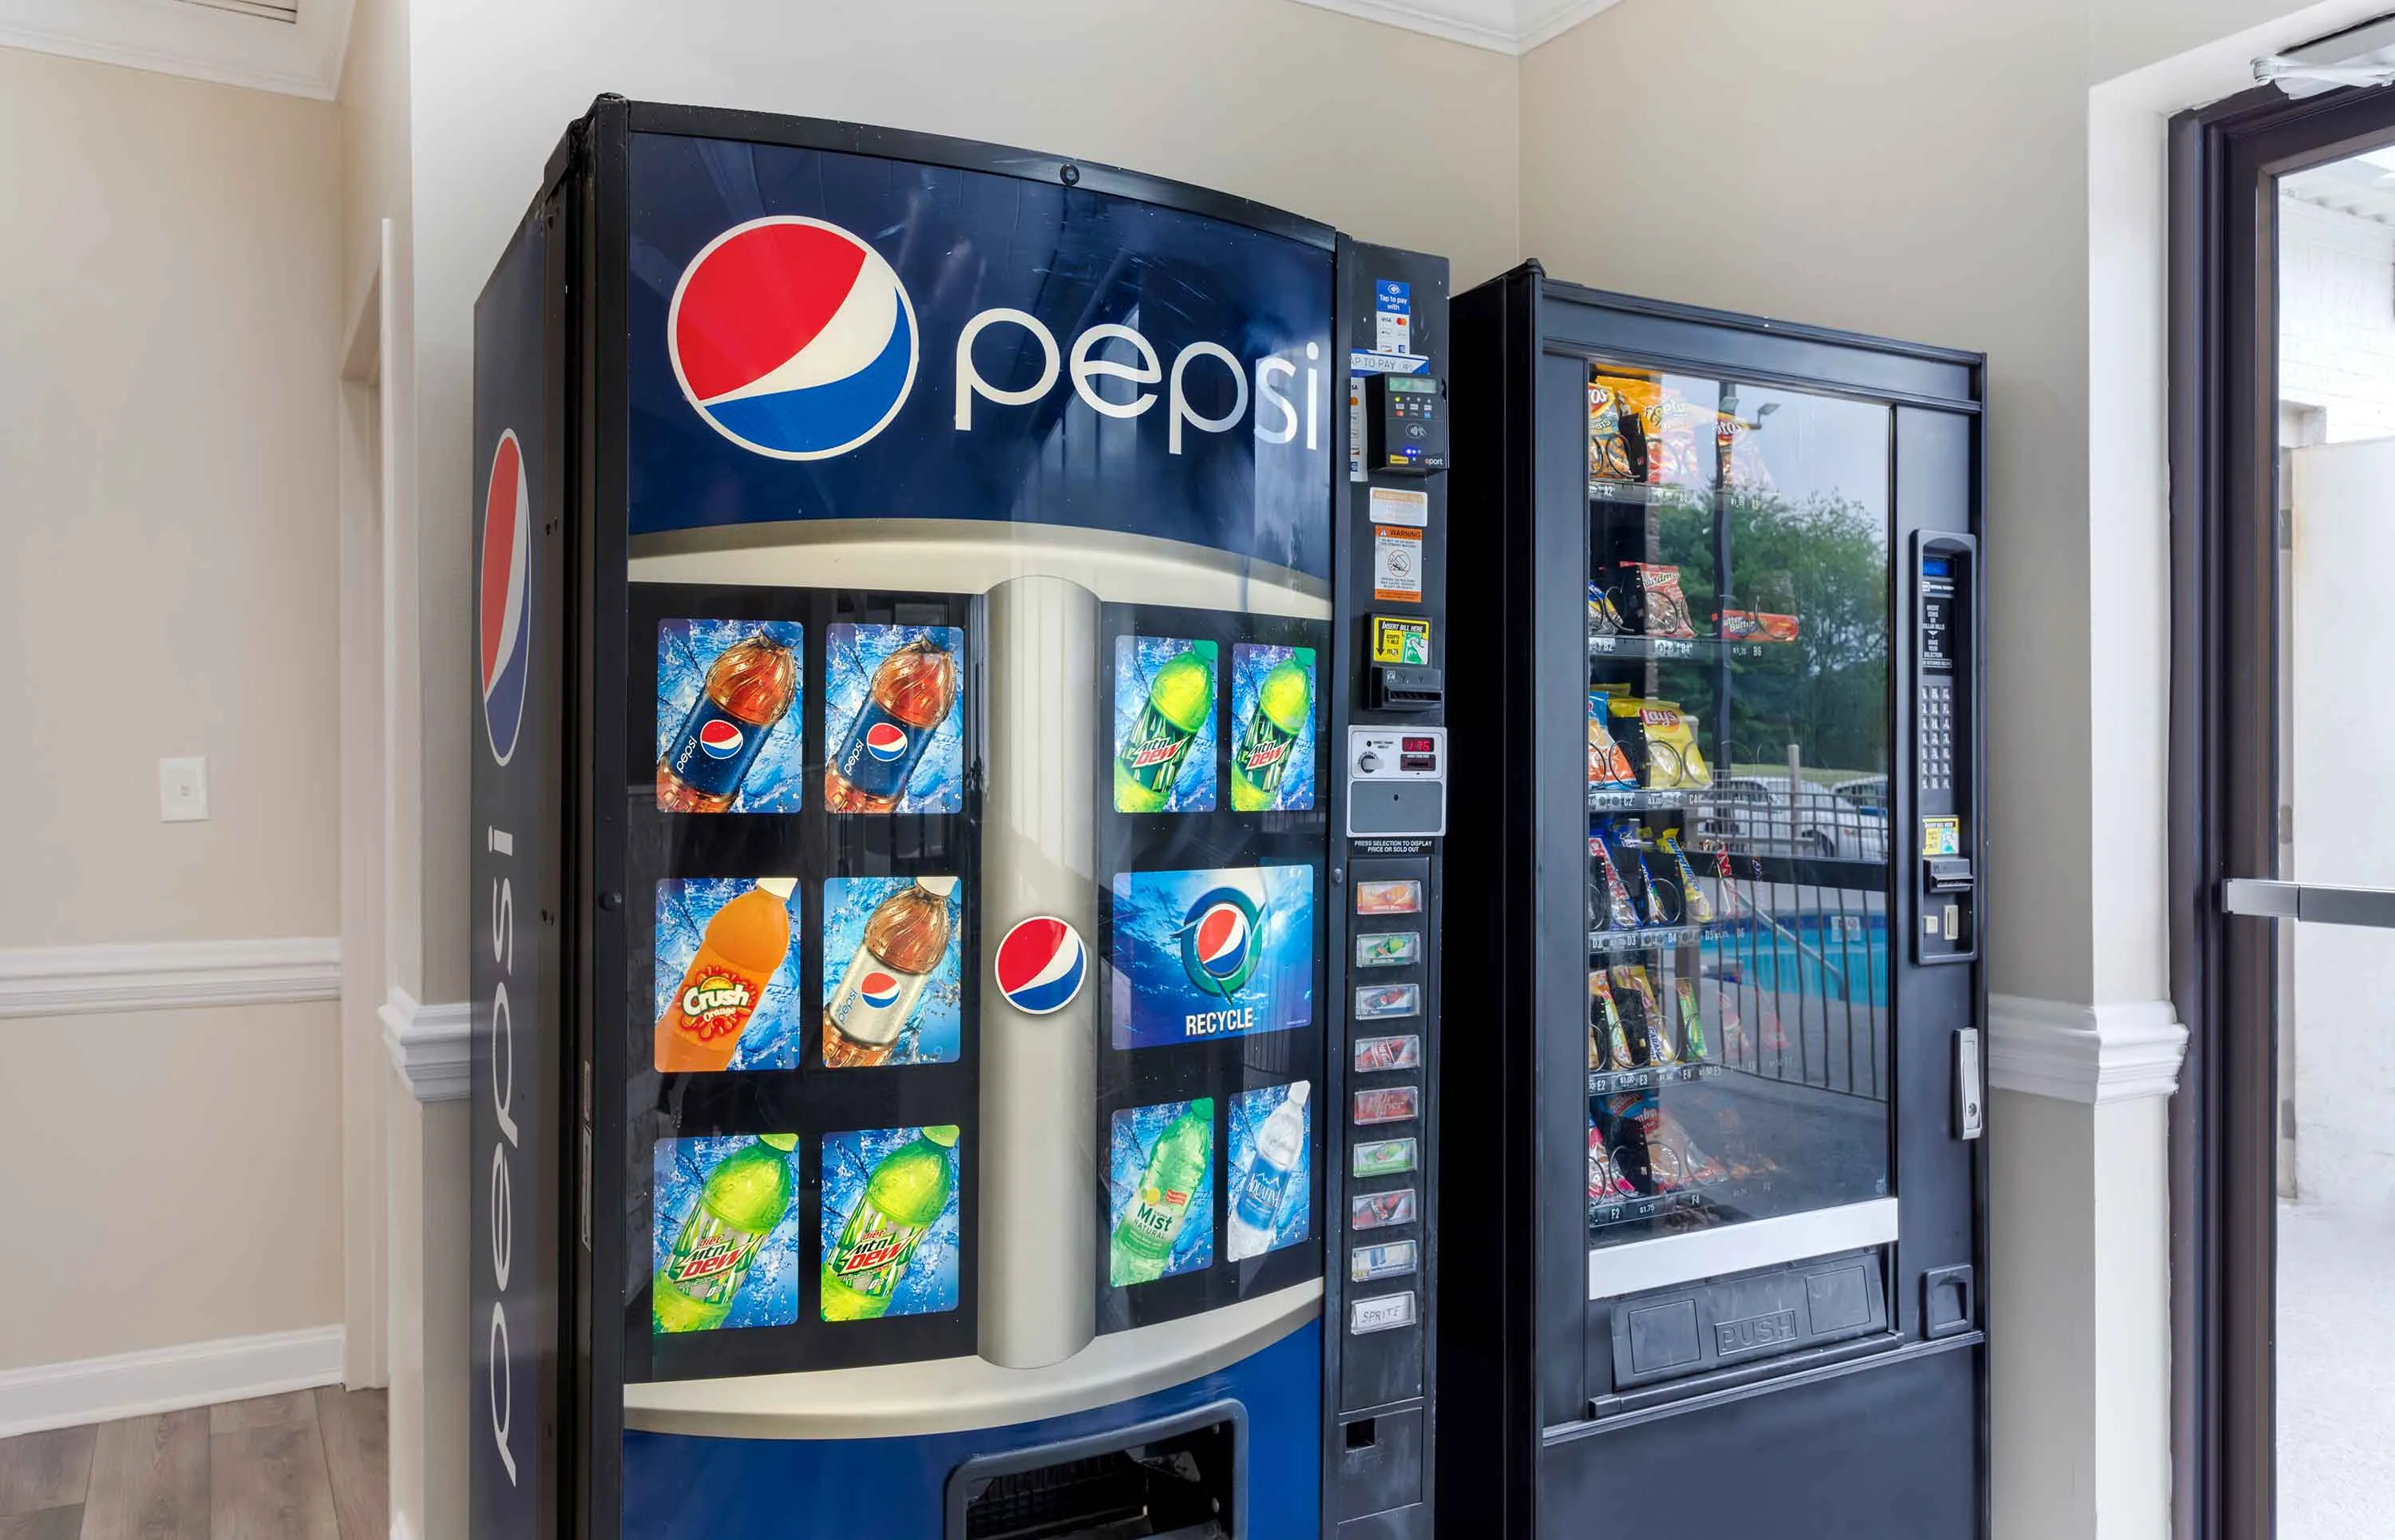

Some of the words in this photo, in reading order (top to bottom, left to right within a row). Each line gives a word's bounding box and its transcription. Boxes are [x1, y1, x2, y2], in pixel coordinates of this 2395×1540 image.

[1380, 294, 1390, 303] Tap
[1351, 356, 1361, 366] AP
[1363, 358, 1376, 367] TO
[1378, 360, 1396, 369] PAY
[955, 307, 1320, 454] pepsi
[1390, 529, 1421, 538] WARNING
[677, 737, 696, 773] pepsi
[844, 741, 864, 776] pepsi
[683, 984, 750, 1015] Crush
[838, 988, 857, 1025] pepsi
[703, 1007, 736, 1022] Orange
[1186, 1008, 1253, 1036] RECYCLE
[489, 825, 517, 1487] pepsi
[1134, 1219, 1166, 1239] NATURAL
[1137, 1202, 1172, 1232] Mist
[699, 1236, 722, 1247] diet
[862, 1229, 885, 1240] diet
[1722, 1314, 1795, 1351] PUSH
